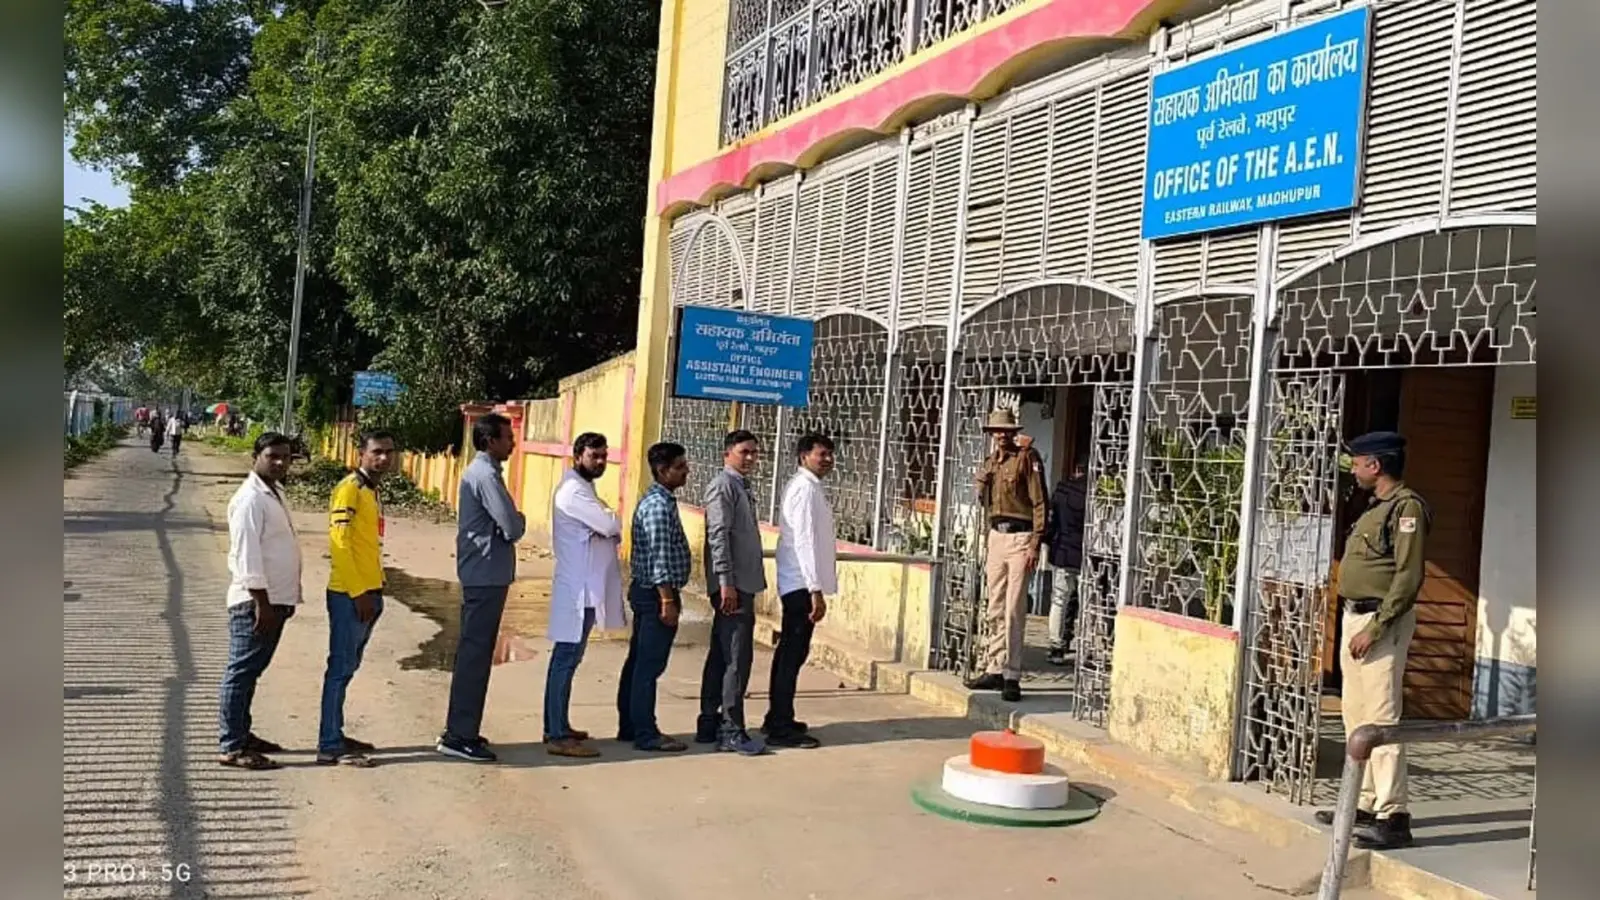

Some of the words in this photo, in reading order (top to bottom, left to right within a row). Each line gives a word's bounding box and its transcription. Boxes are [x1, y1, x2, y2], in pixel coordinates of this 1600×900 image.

[1154, 86, 1201, 126] सहायक
[1203, 62, 1259, 113] अभियंता
[1267, 60, 1288, 94] का
[1291, 34, 1359, 89] कार्यालय
[1197, 119, 1215, 149] पूर्व
[1254, 104, 1297, 134] मधुपुर
[1153, 160, 1211, 201] OFFICE
[1216, 153, 1240, 188] OF
[1244, 144, 1280, 182] THE
[1284, 131, 1343, 174] A.E.N.
[1164, 204, 1206, 224] EASTERN
[1208, 198, 1253, 218] RAILWAY,
[1256, 184, 1321, 208] MADHUPUR
[695, 323, 745, 339] सहायक
[686, 360, 745, 375] ASSISTANT
[749, 366, 803, 381] ENGINEER
